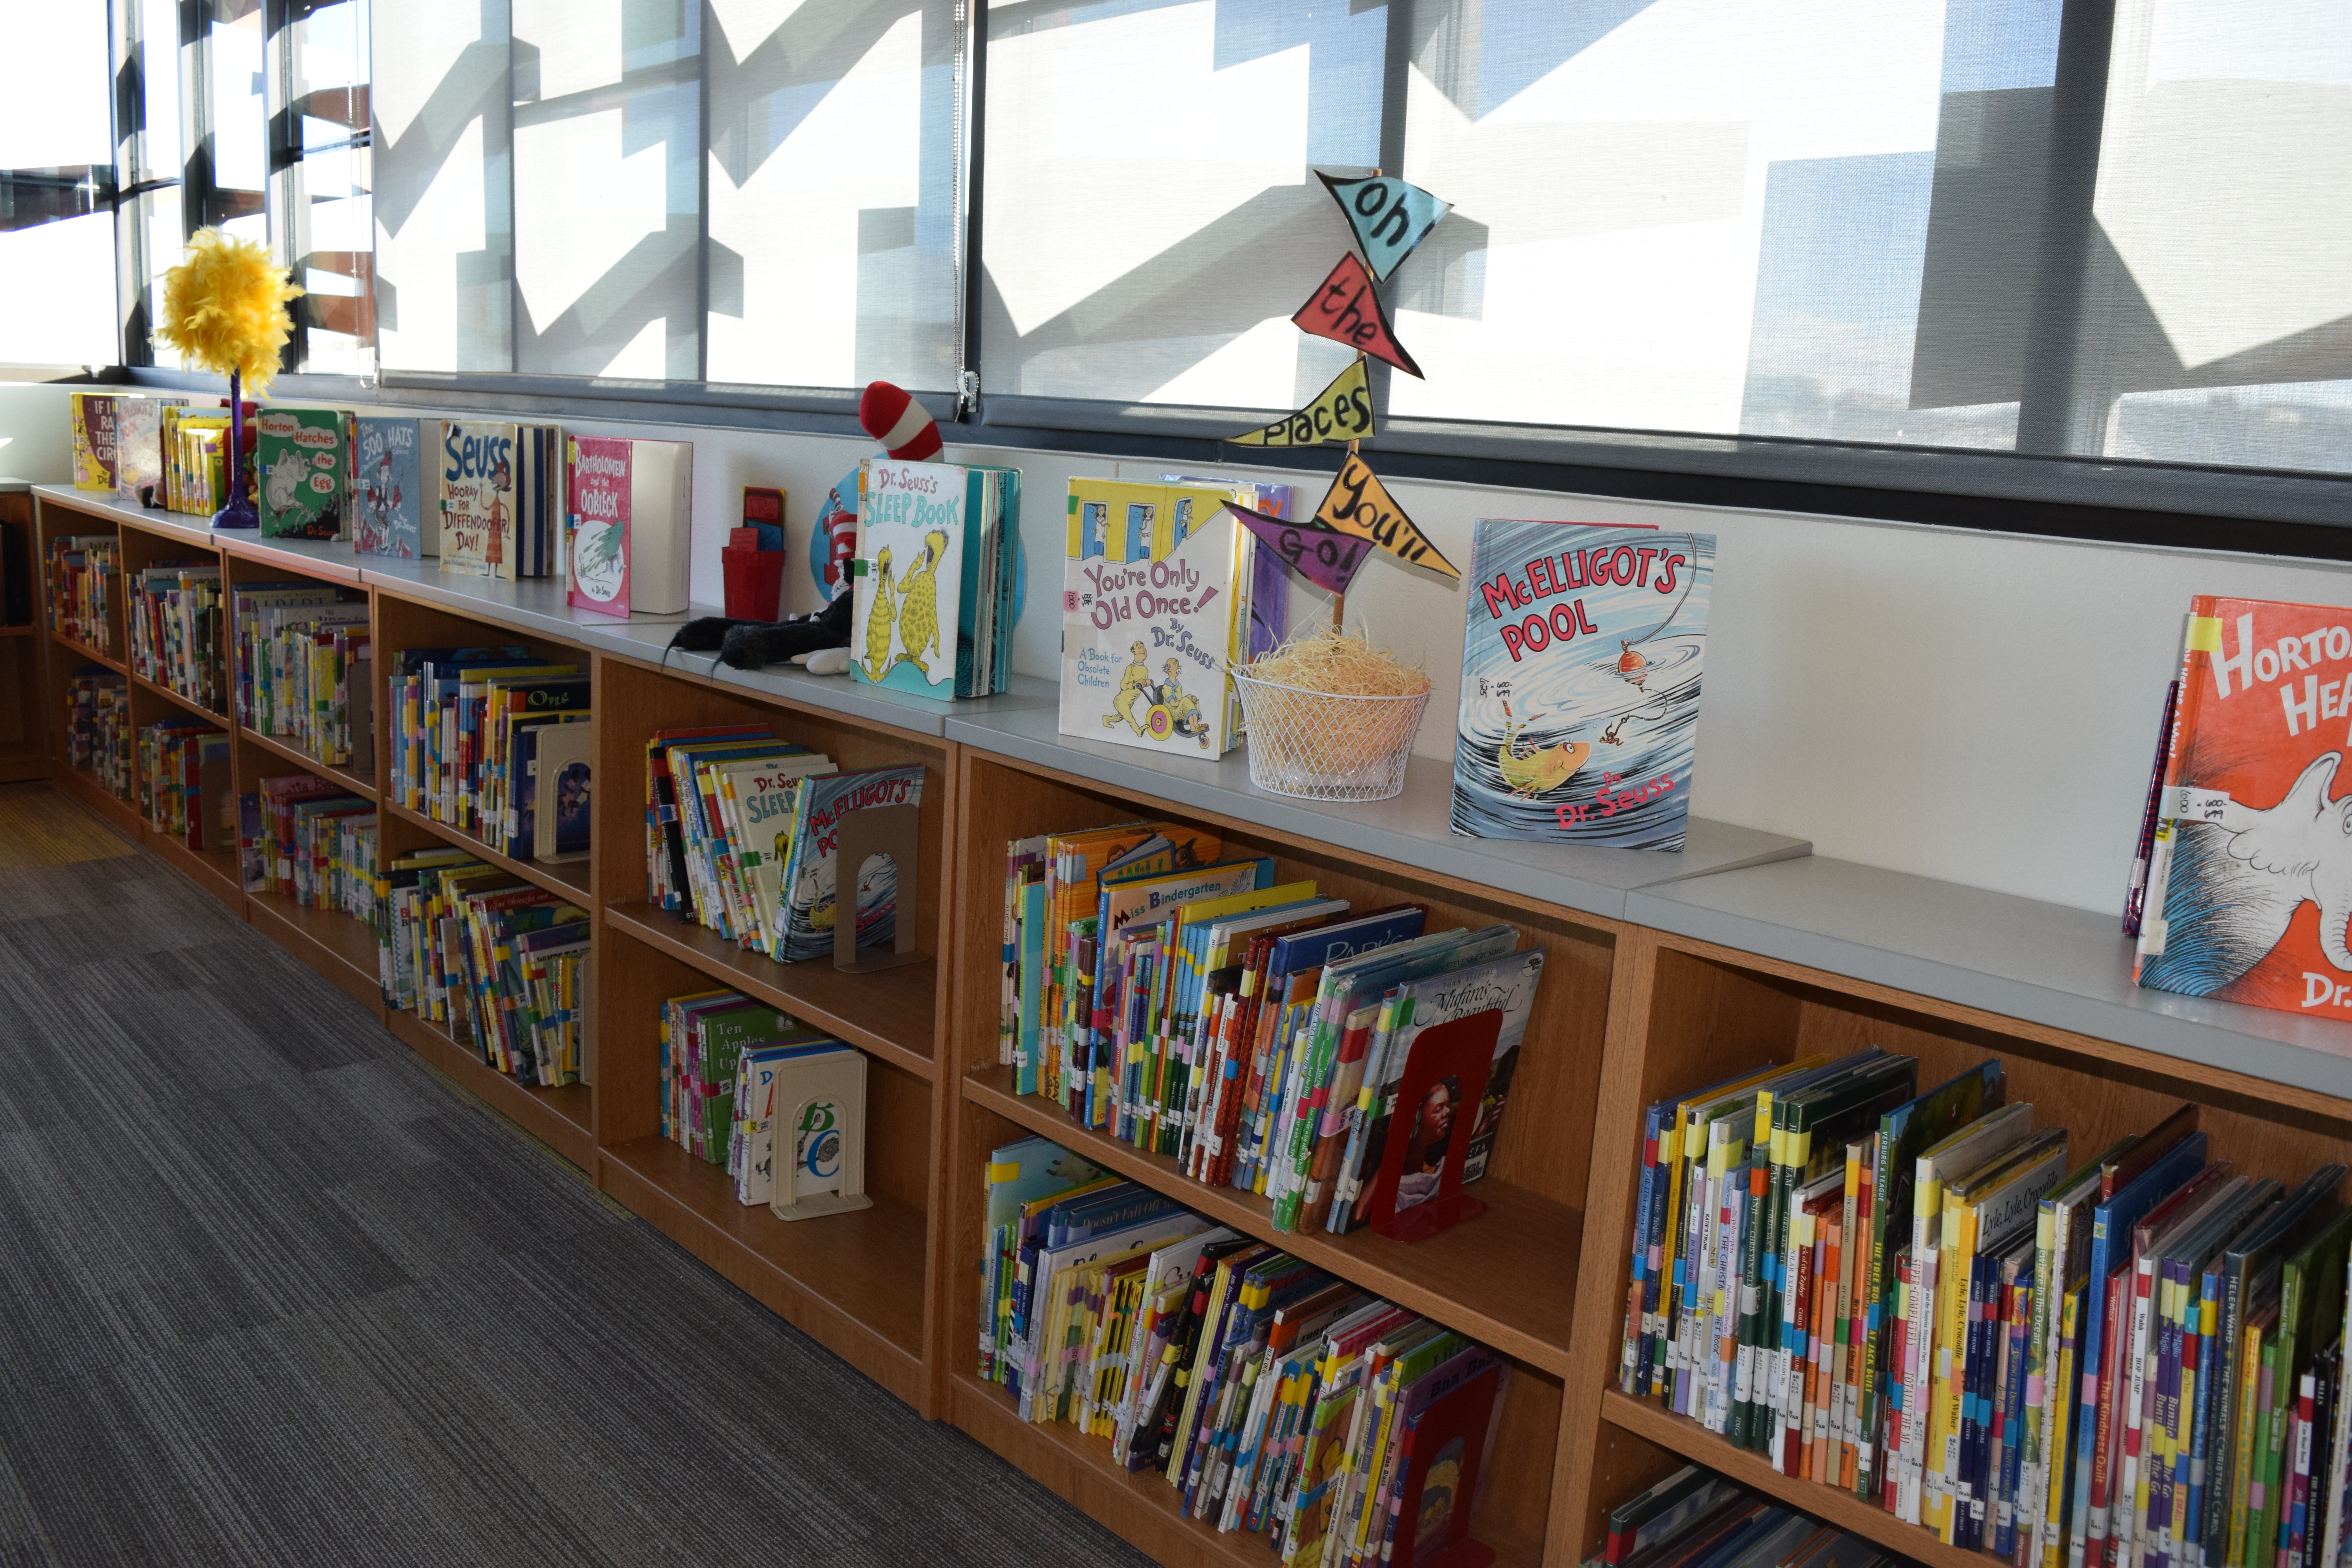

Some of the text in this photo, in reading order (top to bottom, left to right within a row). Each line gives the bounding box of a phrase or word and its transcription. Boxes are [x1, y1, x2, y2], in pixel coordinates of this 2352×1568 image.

[1320, 277, 1377, 345] the
[94, 400, 103, 414] IF
[1263, 386, 1371, 447] Places
[101, 416, 114, 430] RA
[262, 419, 294, 432] Horton
[359, 423, 374, 437] The
[96, 432, 114, 445] THE
[294, 432, 334, 445] Hatches
[363, 432, 383, 461] 500
[387, 426, 414, 448] HATS
[96, 447, 116, 460] CIR
[317, 456, 332, 466] the
[575, 442, 626, 478] BARTHOLOMEW
[314, 477, 332, 490] Egg
[447, 483, 478, 501] HOORAY
[878, 467, 938, 494] Dr. Seuss's
[458, 499, 470, 511] FOR
[581, 488, 618, 518] OOBLECK
[865, 491, 960, 528] SLEEP BOOK
[307, 526, 337, 536] Dr. Seuss
[443, 511, 508, 533] DIFFENDOOFER
[456, 531, 479, 551] DAY!
[1083, 559, 1200, 597] You're Only
[1480, 545, 1686, 620] McELLIGOT'S
[1091, 586, 1219, 630] Old Once!
[1170, 617, 1184, 632] By
[1499, 599, 1599, 662] POOL
[1080, 648, 1123, 664] A Book for
[1151, 626, 1216, 670] Dr. Seuss
[1077, 661, 1111, 675] Obsolete
[1077, 673, 1110, 689] Children
[754, 774, 803, 792] Dr. Seus
[1602, 771, 1622, 789] By
[747, 789, 797, 824] SLEEP
[809, 777, 912, 837] McELLIGOT'S
[1555, 772, 1675, 829] Dr. Seuss
[1112, 881, 1221, 930] Miss Bindergarten
[1354, 986, 1376, 997] JANET
[1445, 957, 1473, 971] STEVENS
[1473, 946, 1506, 961] CRUMMEL
[1443, 969, 1494, 989] JOHN STEPTOE
[1423, 980, 1490, 1019] Mufaro's
[717, 1022, 742, 1035] Ten
[721, 1036, 766, 1052] Apples
[719, 1058, 736, 1073] Up
[799, 1102, 835, 1132] B
[1724, 1181, 1733, 1208] Underwood
[1982, 1171, 2058, 1238] Lyle, Lyle, Crocodile
[1083, 1209, 1120, 1228] Doesn't
[1122, 1202, 1142, 1219] Fall
[1955, 1278, 1968, 1359] Lyle, Lyle, Crocodile
[2226, 1276, 2238, 1343] HELEN WARD
[1186, 1325, 1194, 1343] Joseph
[2161, 1332, 2169, 1355] Miglio
[2172, 1334, 2182, 1357] Miglio
[1215, 1352, 1225, 1381] TEAGUE
[2221, 1365, 2230, 1383] THE
[1865, 1368, 1873, 1394] BUILT
[2318, 1380, 2326, 1405] WELLS
[1902, 1372, 1914, 1432] TOTALLY THE
[1383, 1402, 1394, 1429] Duckling
[1951, 1404, 1959, 1429] Waber
[2167, 1395, 2179, 1438] Bunnie
[2094, 1380, 2112, 1483] The Kindness Quilt
[2150, 1460, 2161, 1495] the Go
[2212, 1437, 2229, 1498] CHRISTMAS
[2210, 1499, 2225, 1537] CAROL
